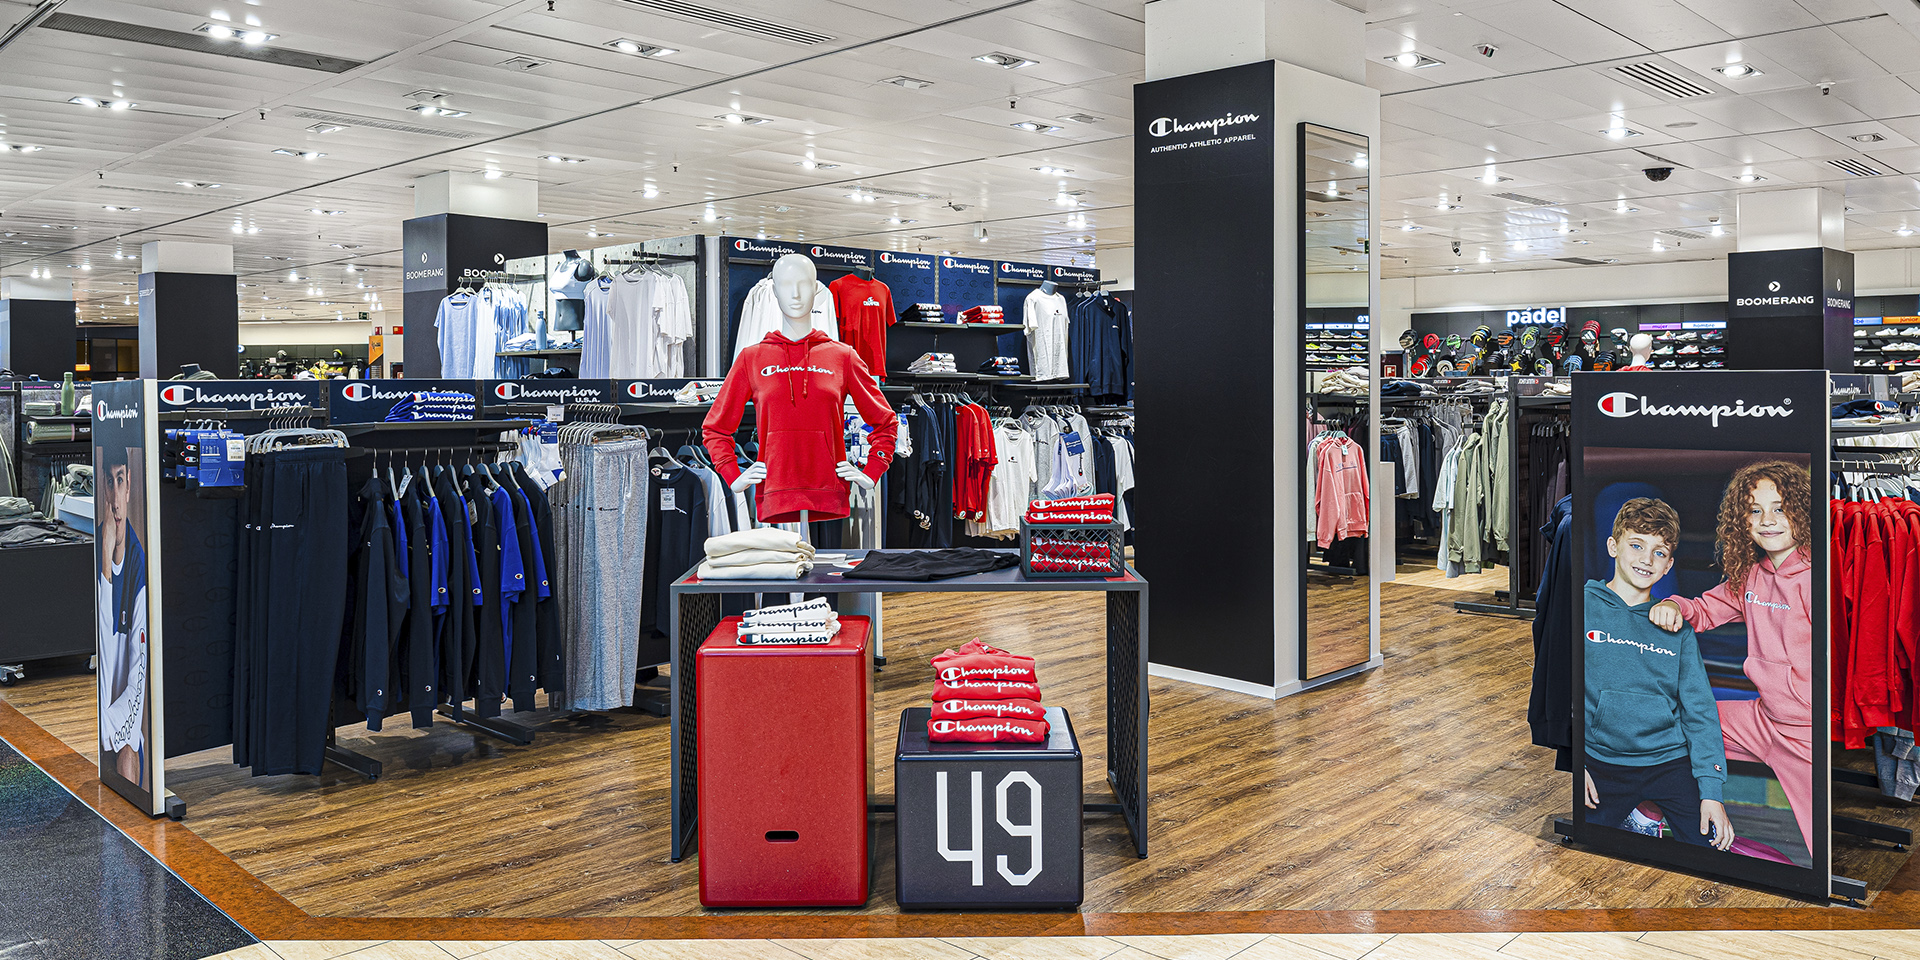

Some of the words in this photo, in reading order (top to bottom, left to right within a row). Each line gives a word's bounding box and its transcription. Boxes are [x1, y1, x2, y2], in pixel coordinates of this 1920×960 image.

[1148, 112, 1260, 138] Champion
[1150, 143, 1188, 154] AUTHENTIC
[1189, 138, 1222, 149] ATHLETIC
[1223, 133, 1256, 144] APPAREL
[734, 239, 796, 257] Champion
[811, 246, 867, 264] Champion
[880, 252, 931, 269] Champion
[943, 258, 991, 274] Champion
[406, 268, 444, 280] BOOMERANG
[1001, 263, 1045, 278] Champion
[1054, 267, 1095, 280] Champion
[1736, 295, 1814, 307] BOOMERANG
[1827, 298, 1851, 310] BOOMERANG
[1506, 306, 1567, 327] pádel
[160, 385, 306, 409] Champion
[495, 382, 601, 404] Champion
[1032, 498, 1113, 510] Champion
[1744, 590, 1792, 613] Champion
[1586, 630, 1677, 657] Champion
[940, 665, 1030, 681] Champion
[942, 700, 1035, 717] Champion
[932, 720, 1035, 738] Champion
[936, 771, 1043, 886] 49
